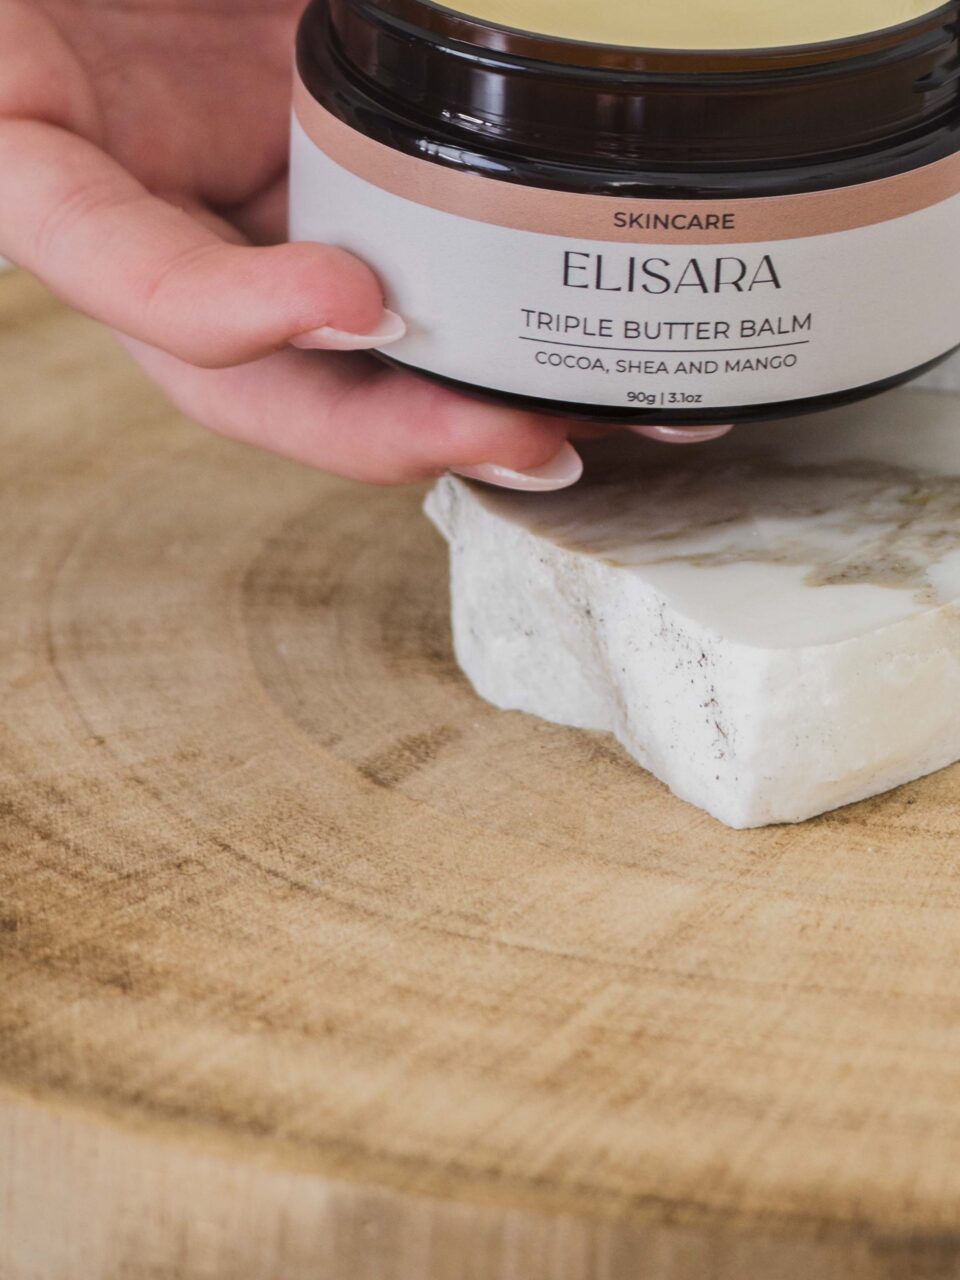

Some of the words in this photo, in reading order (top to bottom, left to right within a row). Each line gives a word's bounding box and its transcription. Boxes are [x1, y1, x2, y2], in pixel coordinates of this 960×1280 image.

[613, 211, 736, 230] SKINCARE
[562, 250, 782, 295] ELISARA
[520, 308, 614, 338] TRIPLE
[623, 320, 730, 341] BUTTER
[739, 312, 813, 338] BALM
[534, 350, 610, 375] COCOA,
[615, 358, 670, 375] SHEA
[673, 361, 719, 375] AND
[724, 353, 798, 374] MANGO
[626, 391, 657, 405] 90g
[667, 391, 704, 404] 3.1oz
